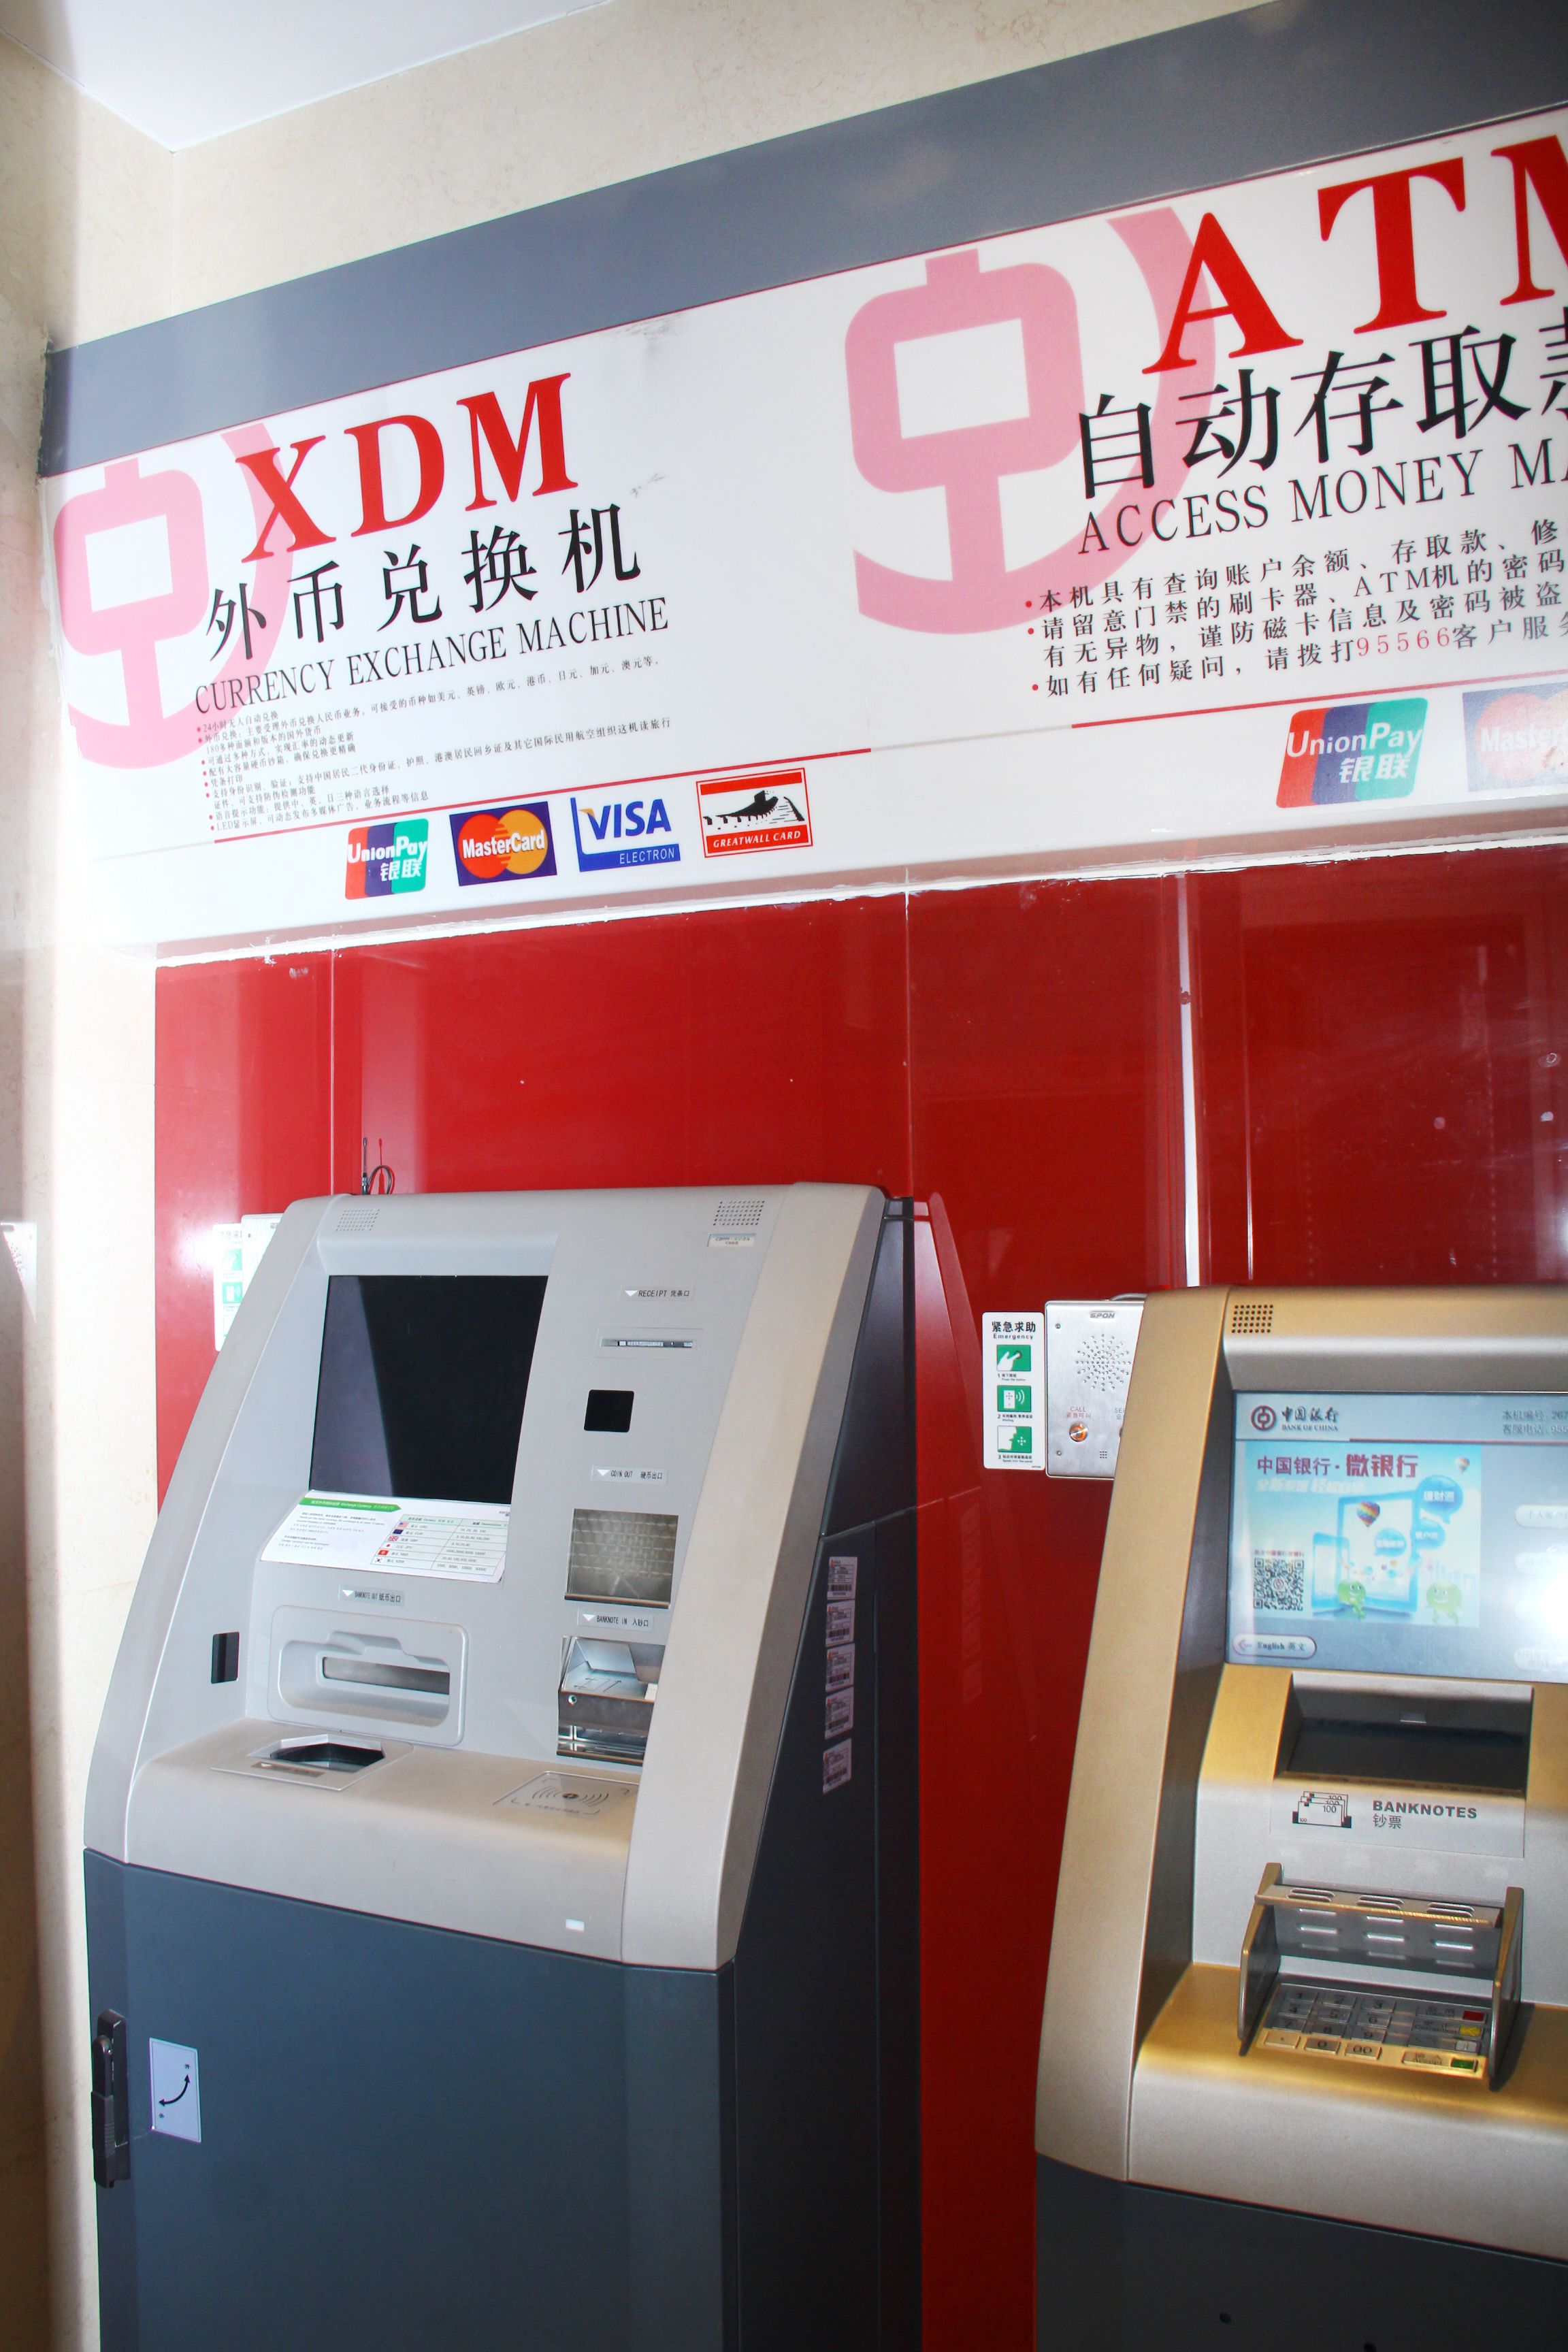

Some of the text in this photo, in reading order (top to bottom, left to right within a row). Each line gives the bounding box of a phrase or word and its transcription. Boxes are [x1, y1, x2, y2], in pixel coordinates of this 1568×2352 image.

[1079, 306, 1568, 500] 自动存取
[235, 372, 578, 564] XDM
[1079, 486, 1270, 554] ACCESS
[1292, 451, 1483, 524] MONEY
[206, 504, 641, 662] 外币兑换机
[195, 596, 669, 715] CURRENCY EXCHANGE MACHINE
[1286, 722, 1423, 759] UnionPay
[1339, 753, 1410, 784] 银联
[578, 799, 672, 840] VISA
[347, 836, 428, 864] UnionPay
[463, 829, 545, 859] MasterCard
[713, 830, 801, 848] GREATWALL CARD
[619, 847, 674, 864] ELECTRON
[380, 859, 421, 882] 银联
[992, 1321, 1036, 1333] 紧急求助
[1281, 1406, 1339, 1422] 中国银行
[640, 1471, 662, 1480] 硬币出口
[597, 1615, 619, 1624] BANKNOTE
[1323, 1805, 1337, 1813] 100
[1373, 1800, 1477, 1819] BANKNOTES
[1373, 1813, 1403, 1829] 钞票
[1353, 2045, 1372, 2054] 00
